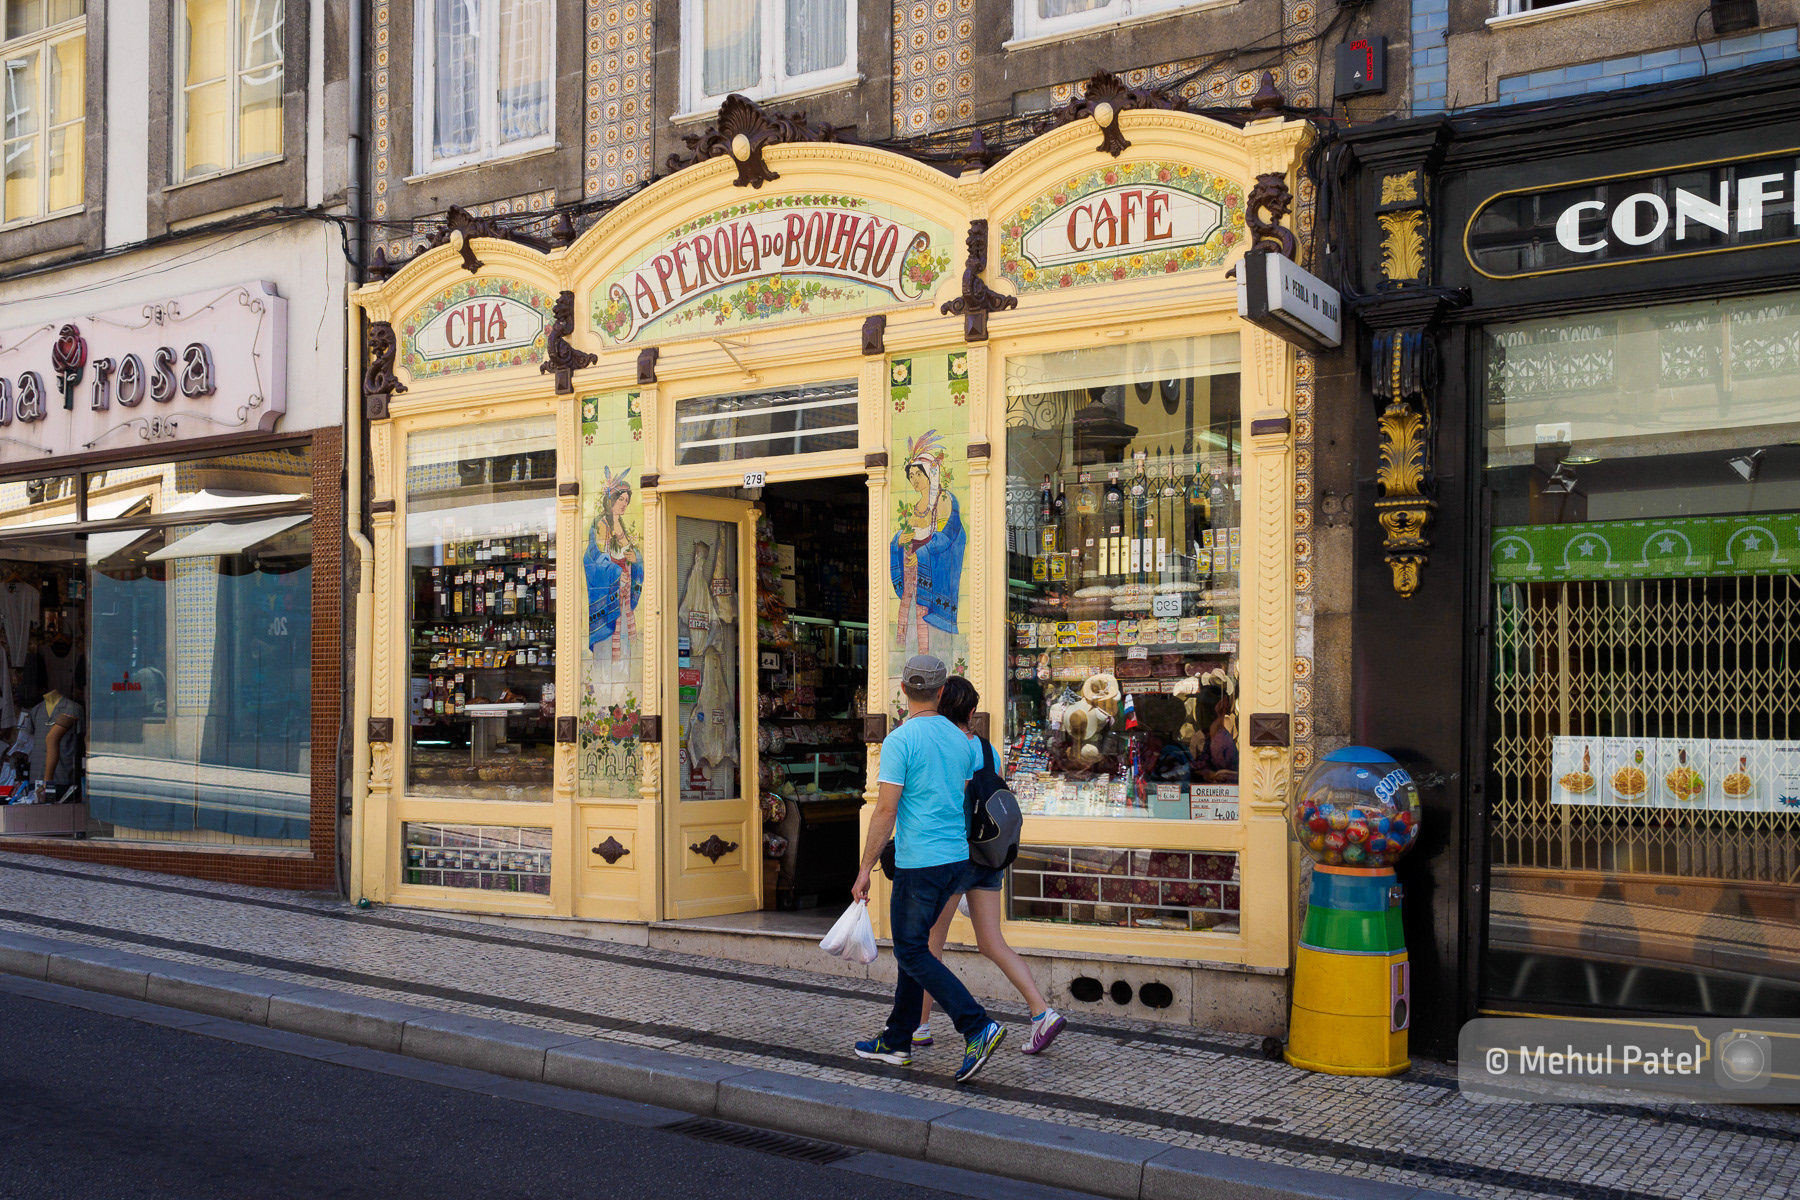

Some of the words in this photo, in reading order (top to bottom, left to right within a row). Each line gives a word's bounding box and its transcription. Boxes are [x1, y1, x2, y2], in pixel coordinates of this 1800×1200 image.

[1066, 189, 1174, 253] CAFÉ
[1555, 172, 1800, 254] CONF
[633, 272, 660, 317] A
[650, 220, 764, 300] PÉROLA
[781, 211, 900, 279] BOLHÃO
[1284, 274, 1290, 292] A
[445, 302, 508, 349] CHÁ
[90, 342, 217, 412] rosa
[745, 475, 763, 485] 279
[1196, 787, 1230, 796] ORELHEIRA
